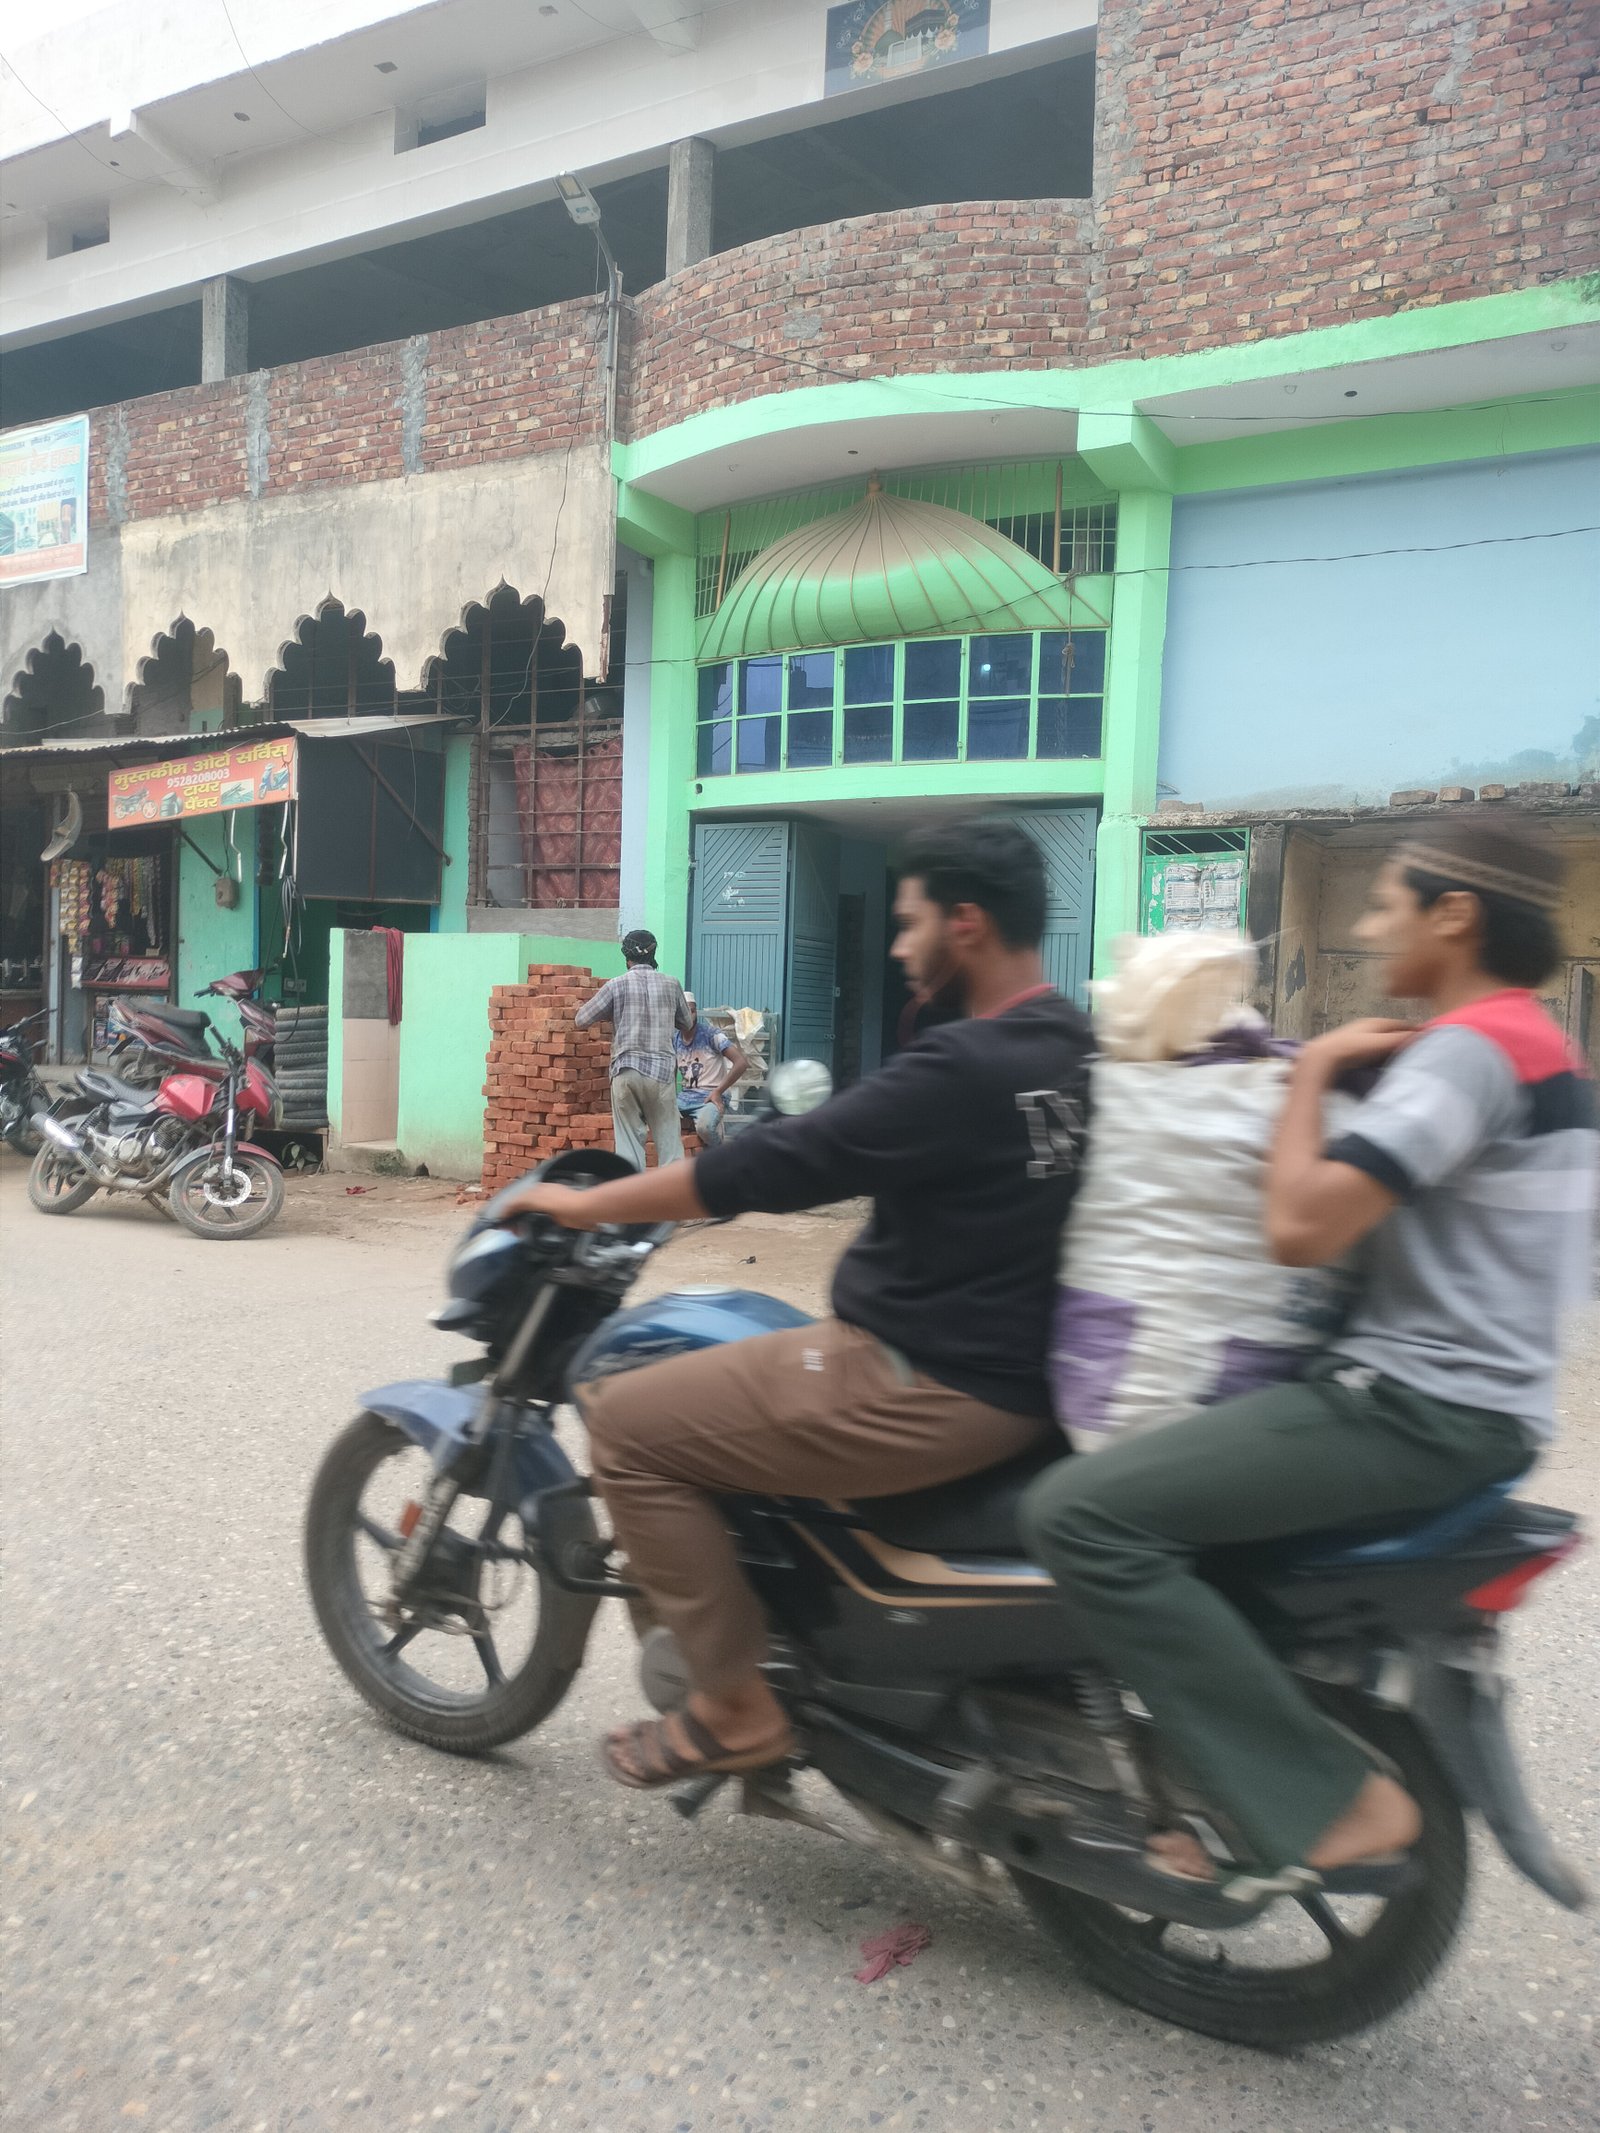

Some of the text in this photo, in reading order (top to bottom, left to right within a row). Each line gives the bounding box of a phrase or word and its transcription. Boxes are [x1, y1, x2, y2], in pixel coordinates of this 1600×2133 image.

[114, 761, 187, 791] मुस्तकीम
[236, 742, 288, 764] सर्विस
[182, 781, 220, 797] टायर
